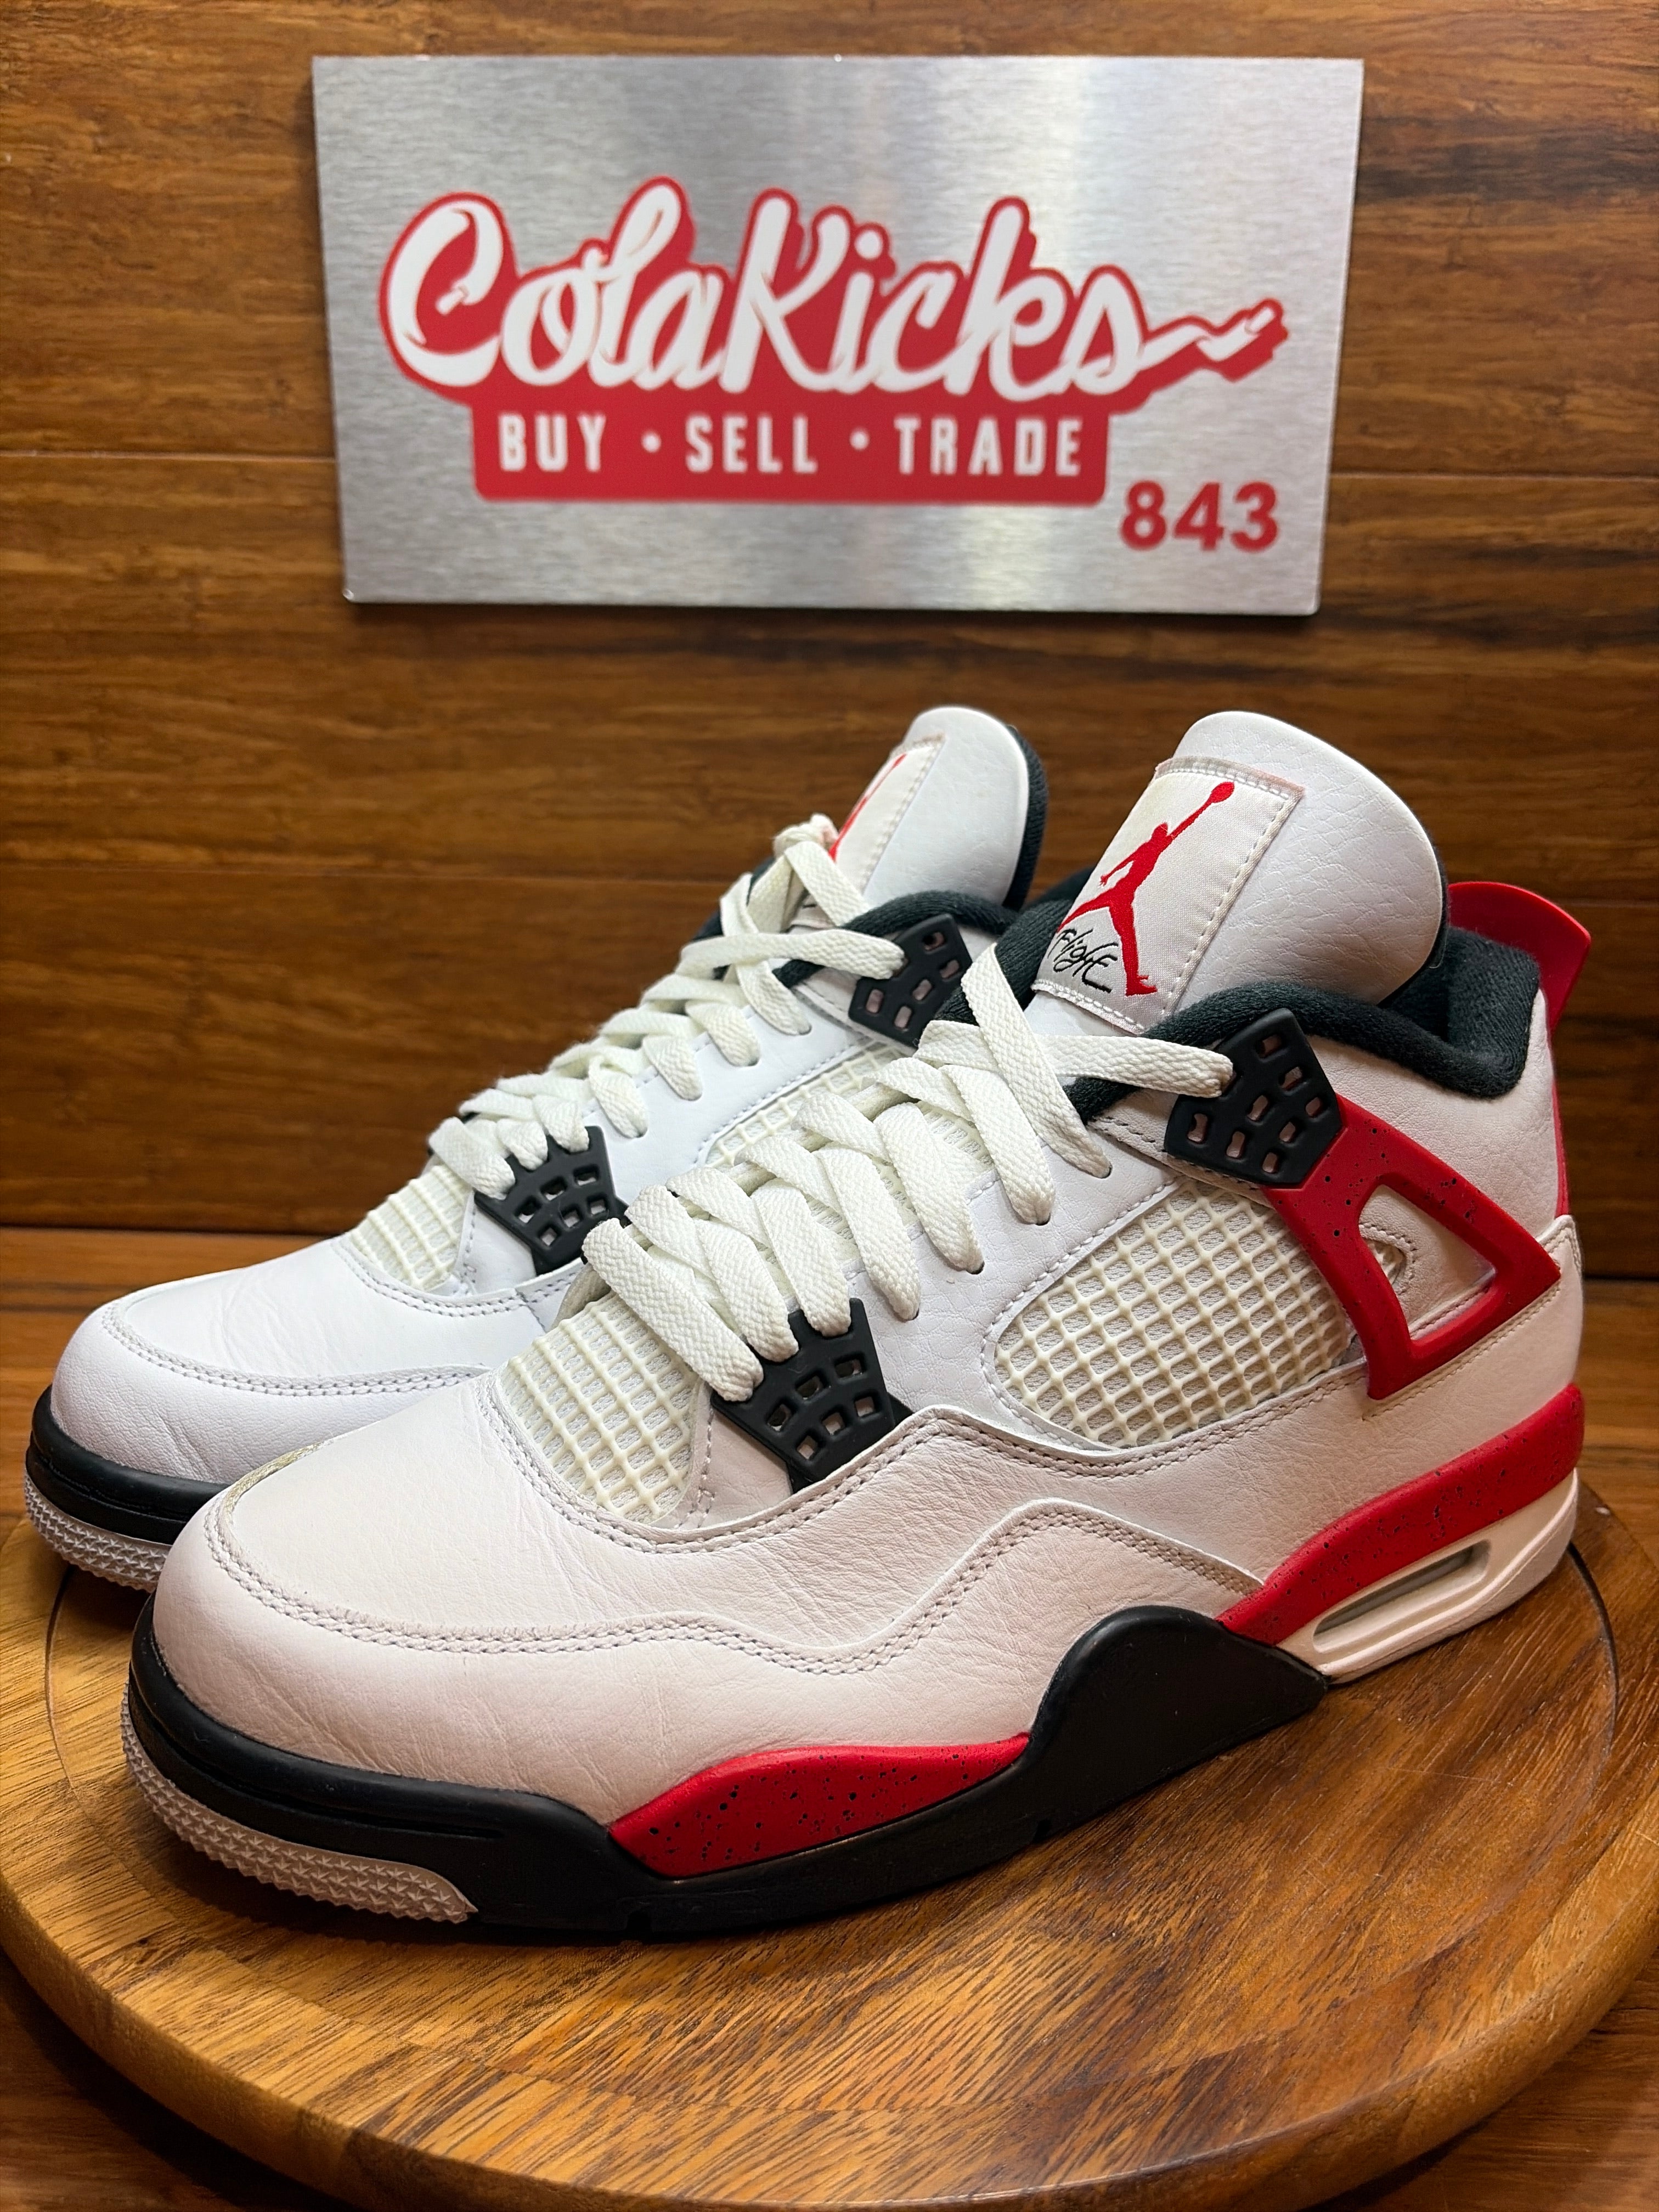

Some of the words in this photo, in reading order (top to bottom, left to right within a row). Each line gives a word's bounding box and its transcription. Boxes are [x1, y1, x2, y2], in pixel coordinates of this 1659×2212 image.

[499, 414, 606, 472] BUY
[685, 415, 817, 473] SELL
[894, 417, 1081, 476] TRADE
[1119, 479, 1280, 553] 843
